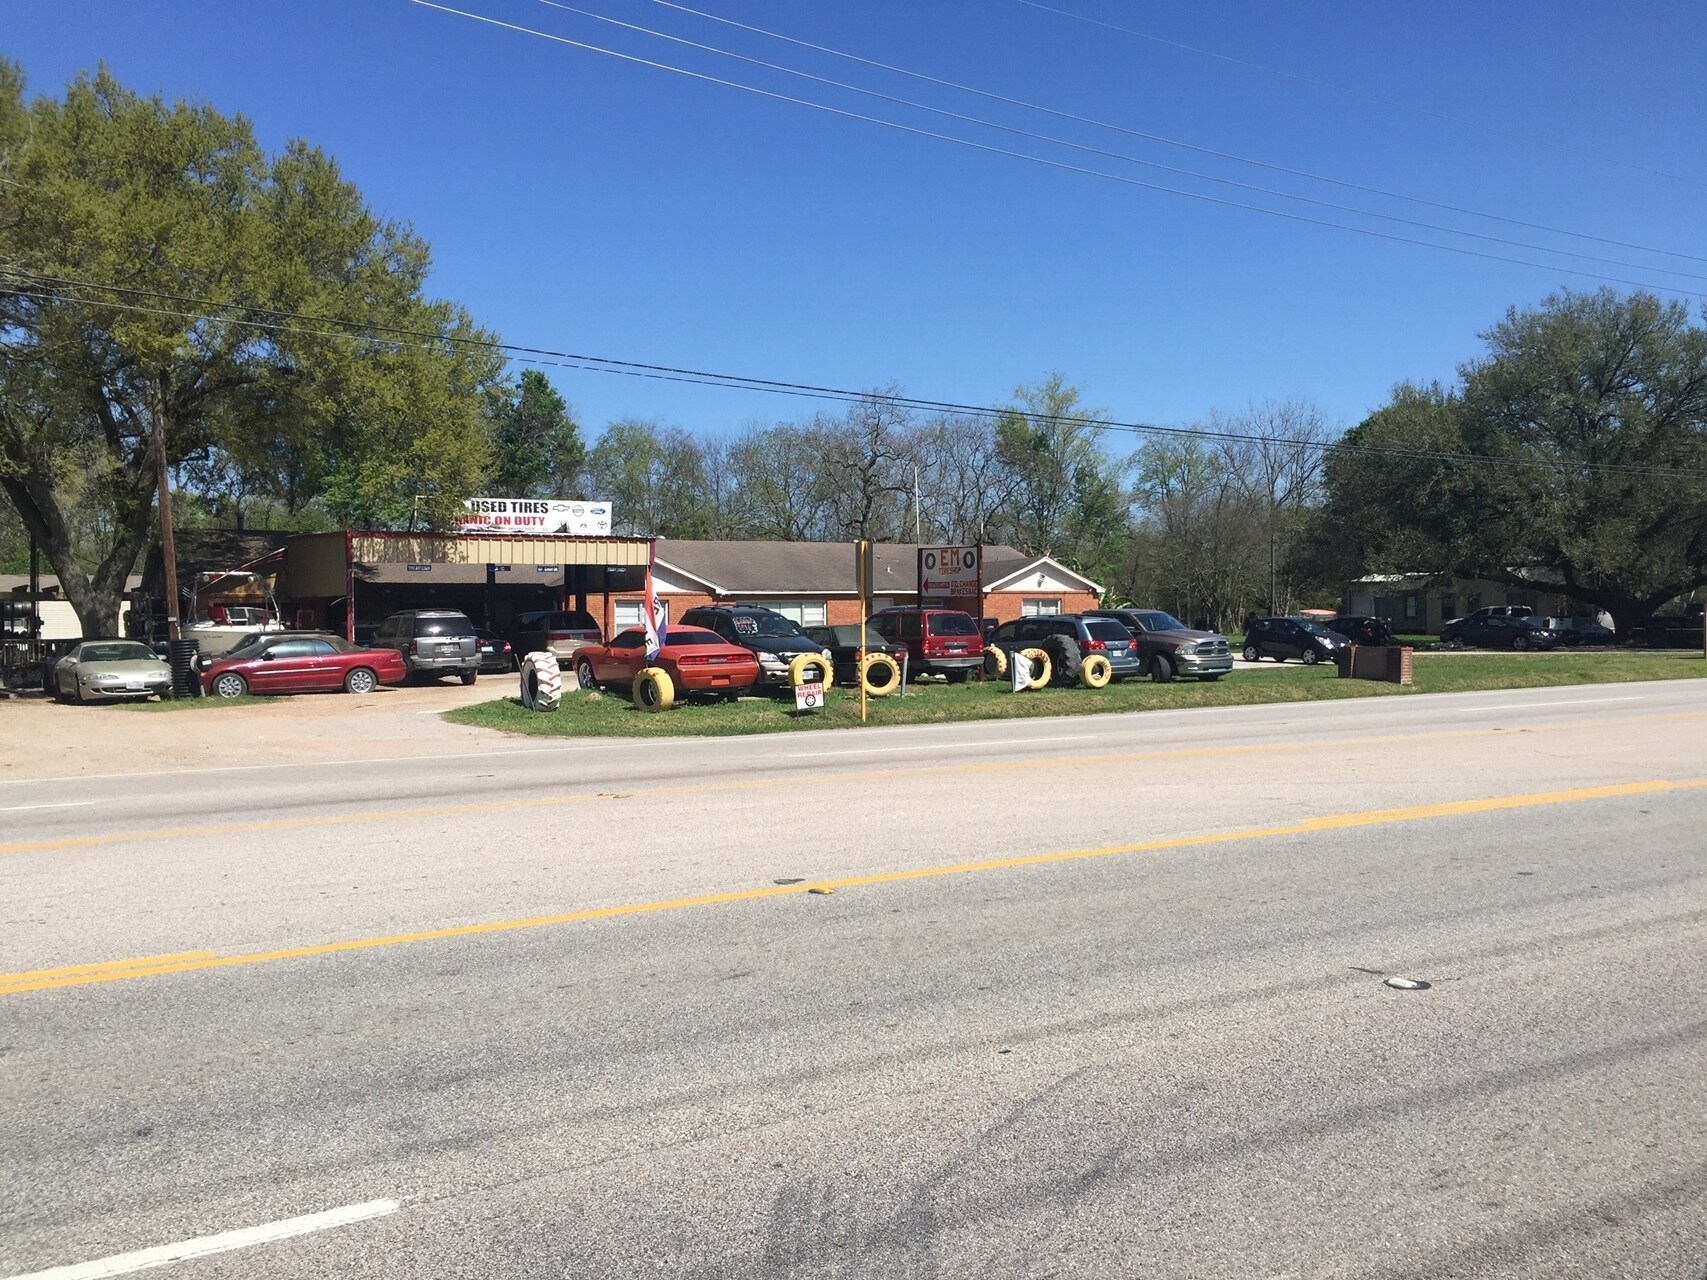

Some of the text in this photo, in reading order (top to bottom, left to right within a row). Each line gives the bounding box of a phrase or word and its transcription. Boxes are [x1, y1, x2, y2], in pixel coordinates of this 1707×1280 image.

[471, 500, 549, 514] USED TIRES
[494, 515, 511, 525] ON
[514, 516, 545, 526] DUTY
[940, 549, 960, 567] EM
[797, 690, 822, 698] REPAIR
